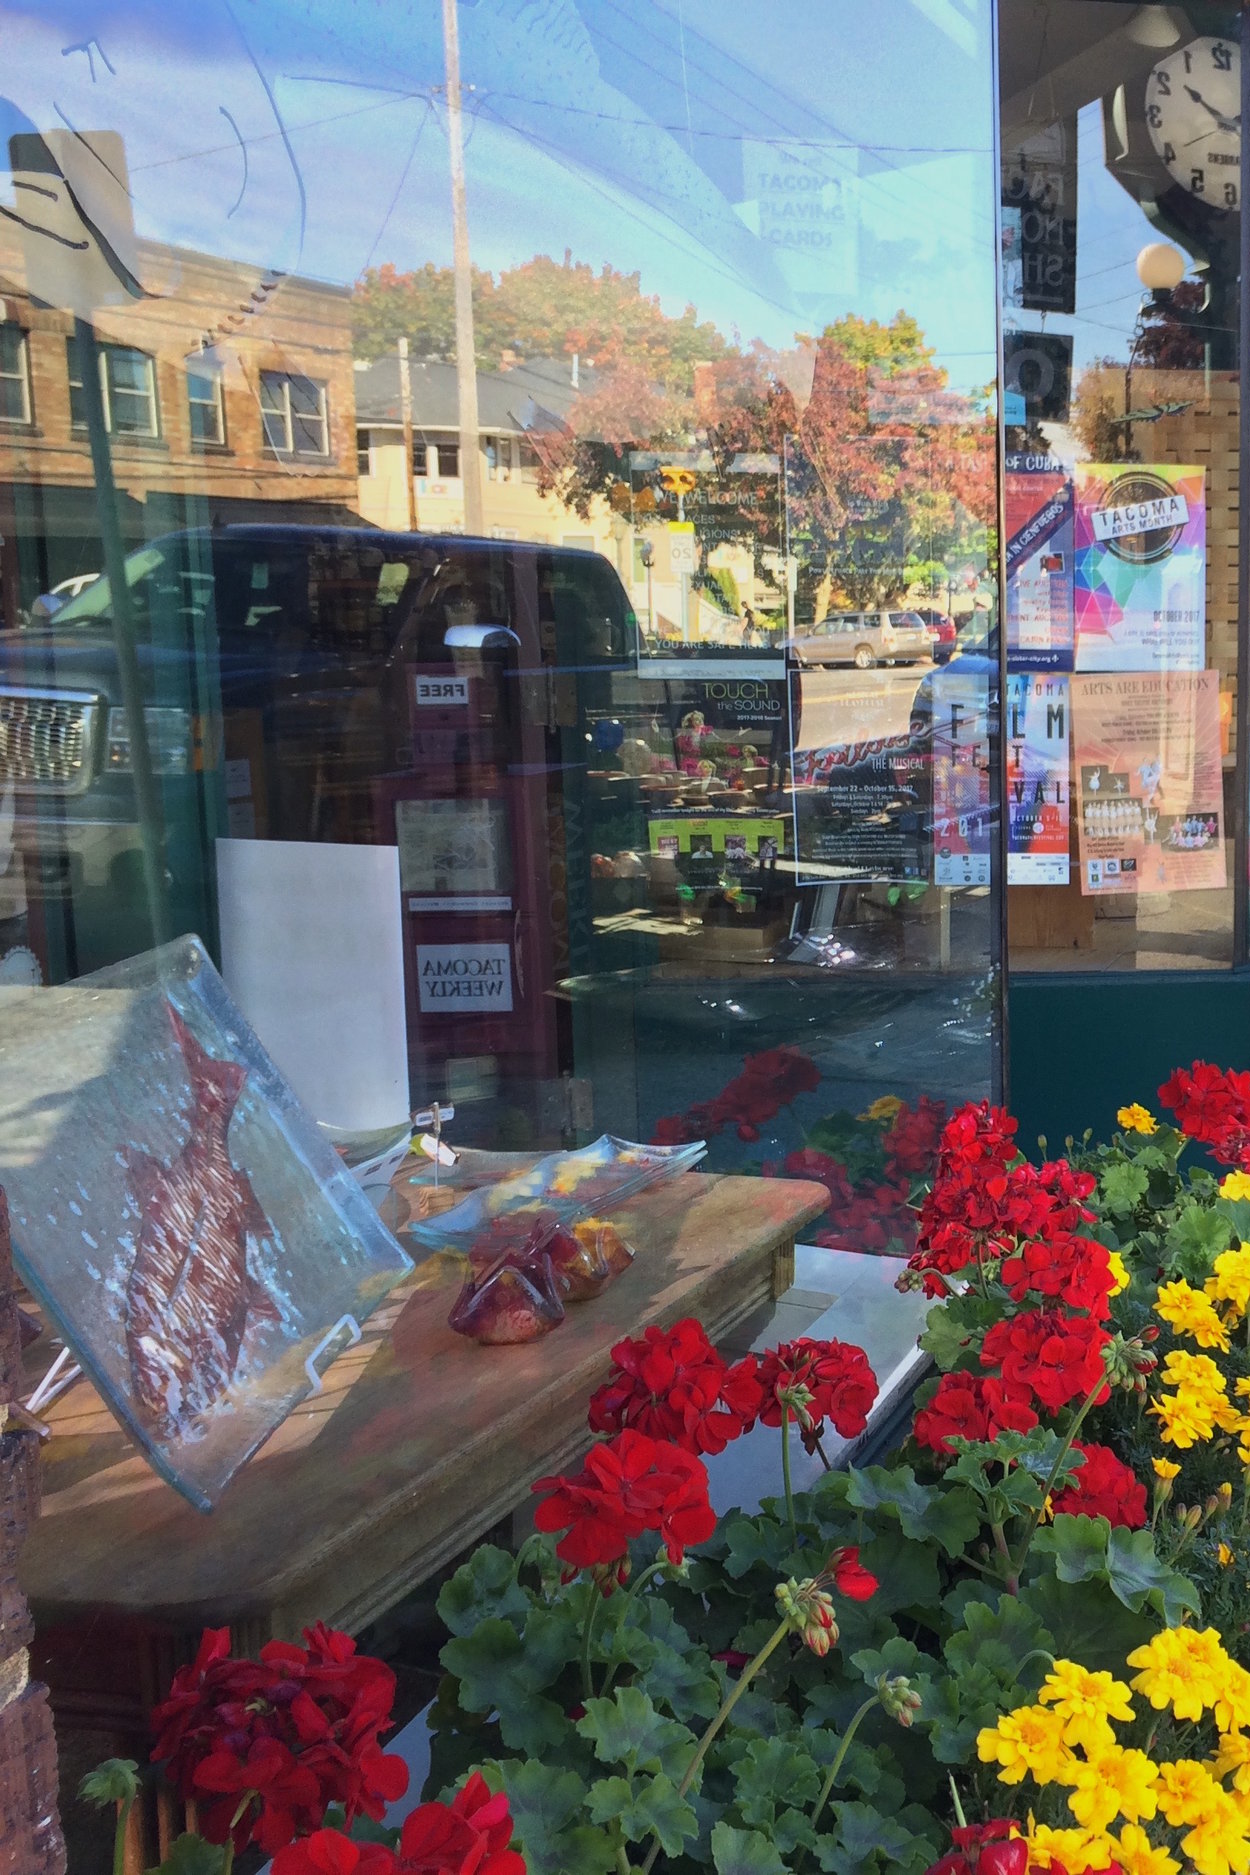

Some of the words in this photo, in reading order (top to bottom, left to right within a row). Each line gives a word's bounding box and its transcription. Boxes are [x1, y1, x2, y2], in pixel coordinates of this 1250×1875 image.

[1099, 498, 1180, 527] TACOMA
[1111, 520, 1137, 536] ARTS
[1138, 514, 1174, 530] MONTH
[655, 640, 680, 649] YOU
[681, 640, 704, 649] ARE
[700, 682, 769, 699] TOUCH
[1081, 682, 1113, 696] ARTS
[1115, 681, 1140, 694] ARE
[718, 701, 733, 711] the
[734, 700, 781, 712] SOUND
[872, 757, 888, 770] THE
[889, 757, 925, 770] MUSICAL
